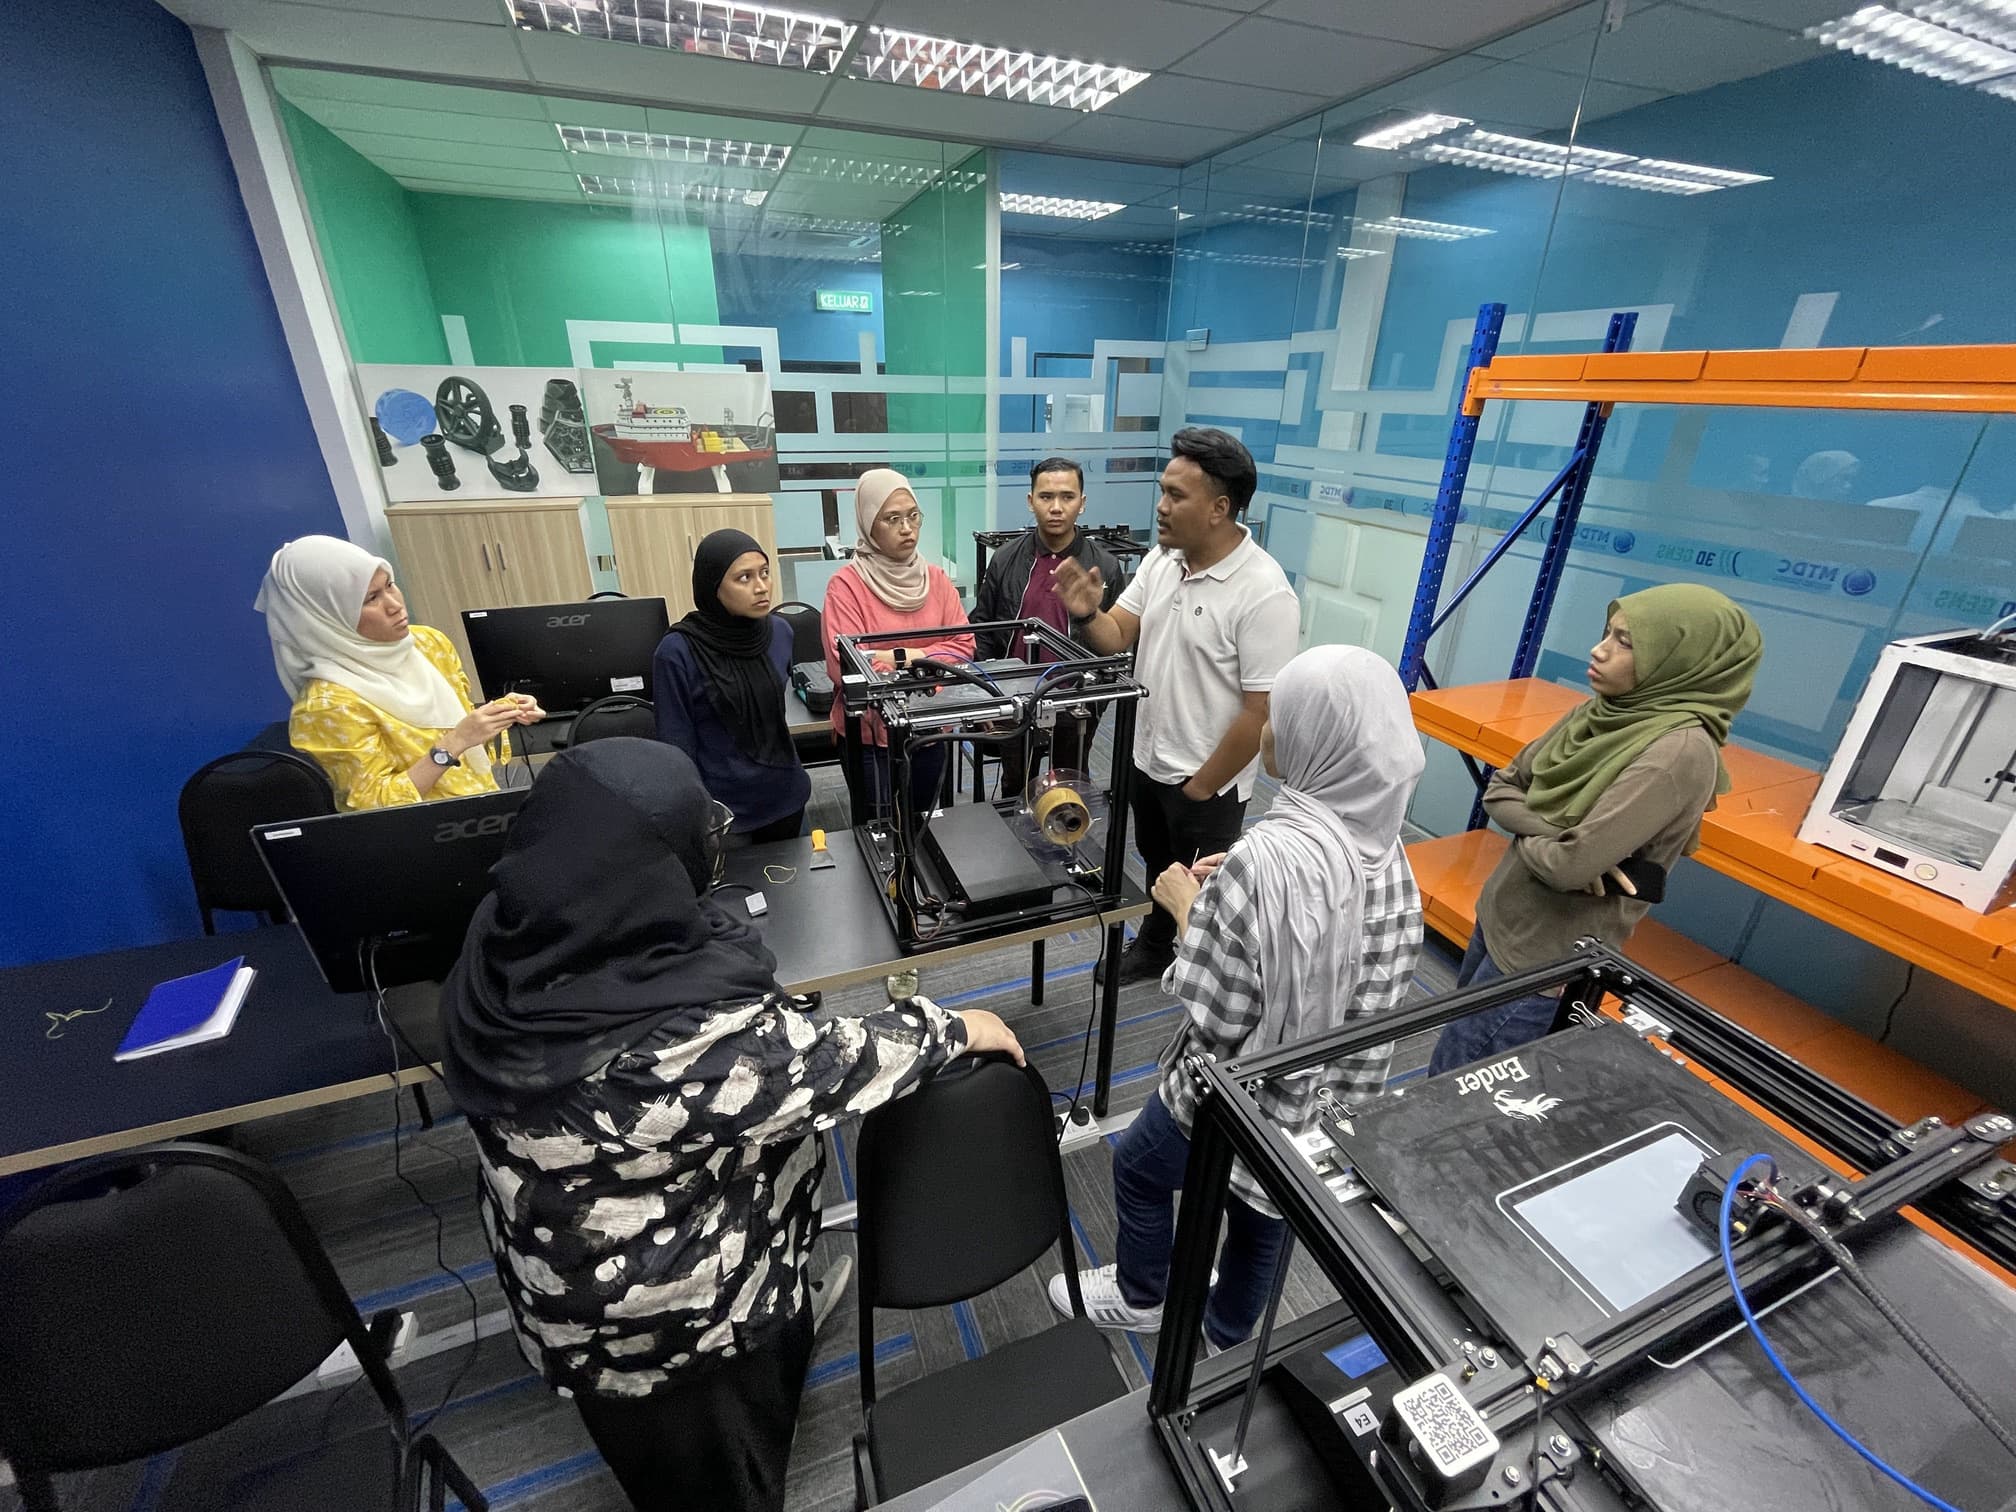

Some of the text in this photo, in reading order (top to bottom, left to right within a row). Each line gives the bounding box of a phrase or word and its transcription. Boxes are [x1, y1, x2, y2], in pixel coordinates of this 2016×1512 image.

[820, 293, 859, 309] KELUAR
[547, 603, 592, 628] acer
[434, 811, 519, 843] acer
[1455, 1056, 1531, 1096] Ender
[1354, 1413, 1371, 1429] E4
